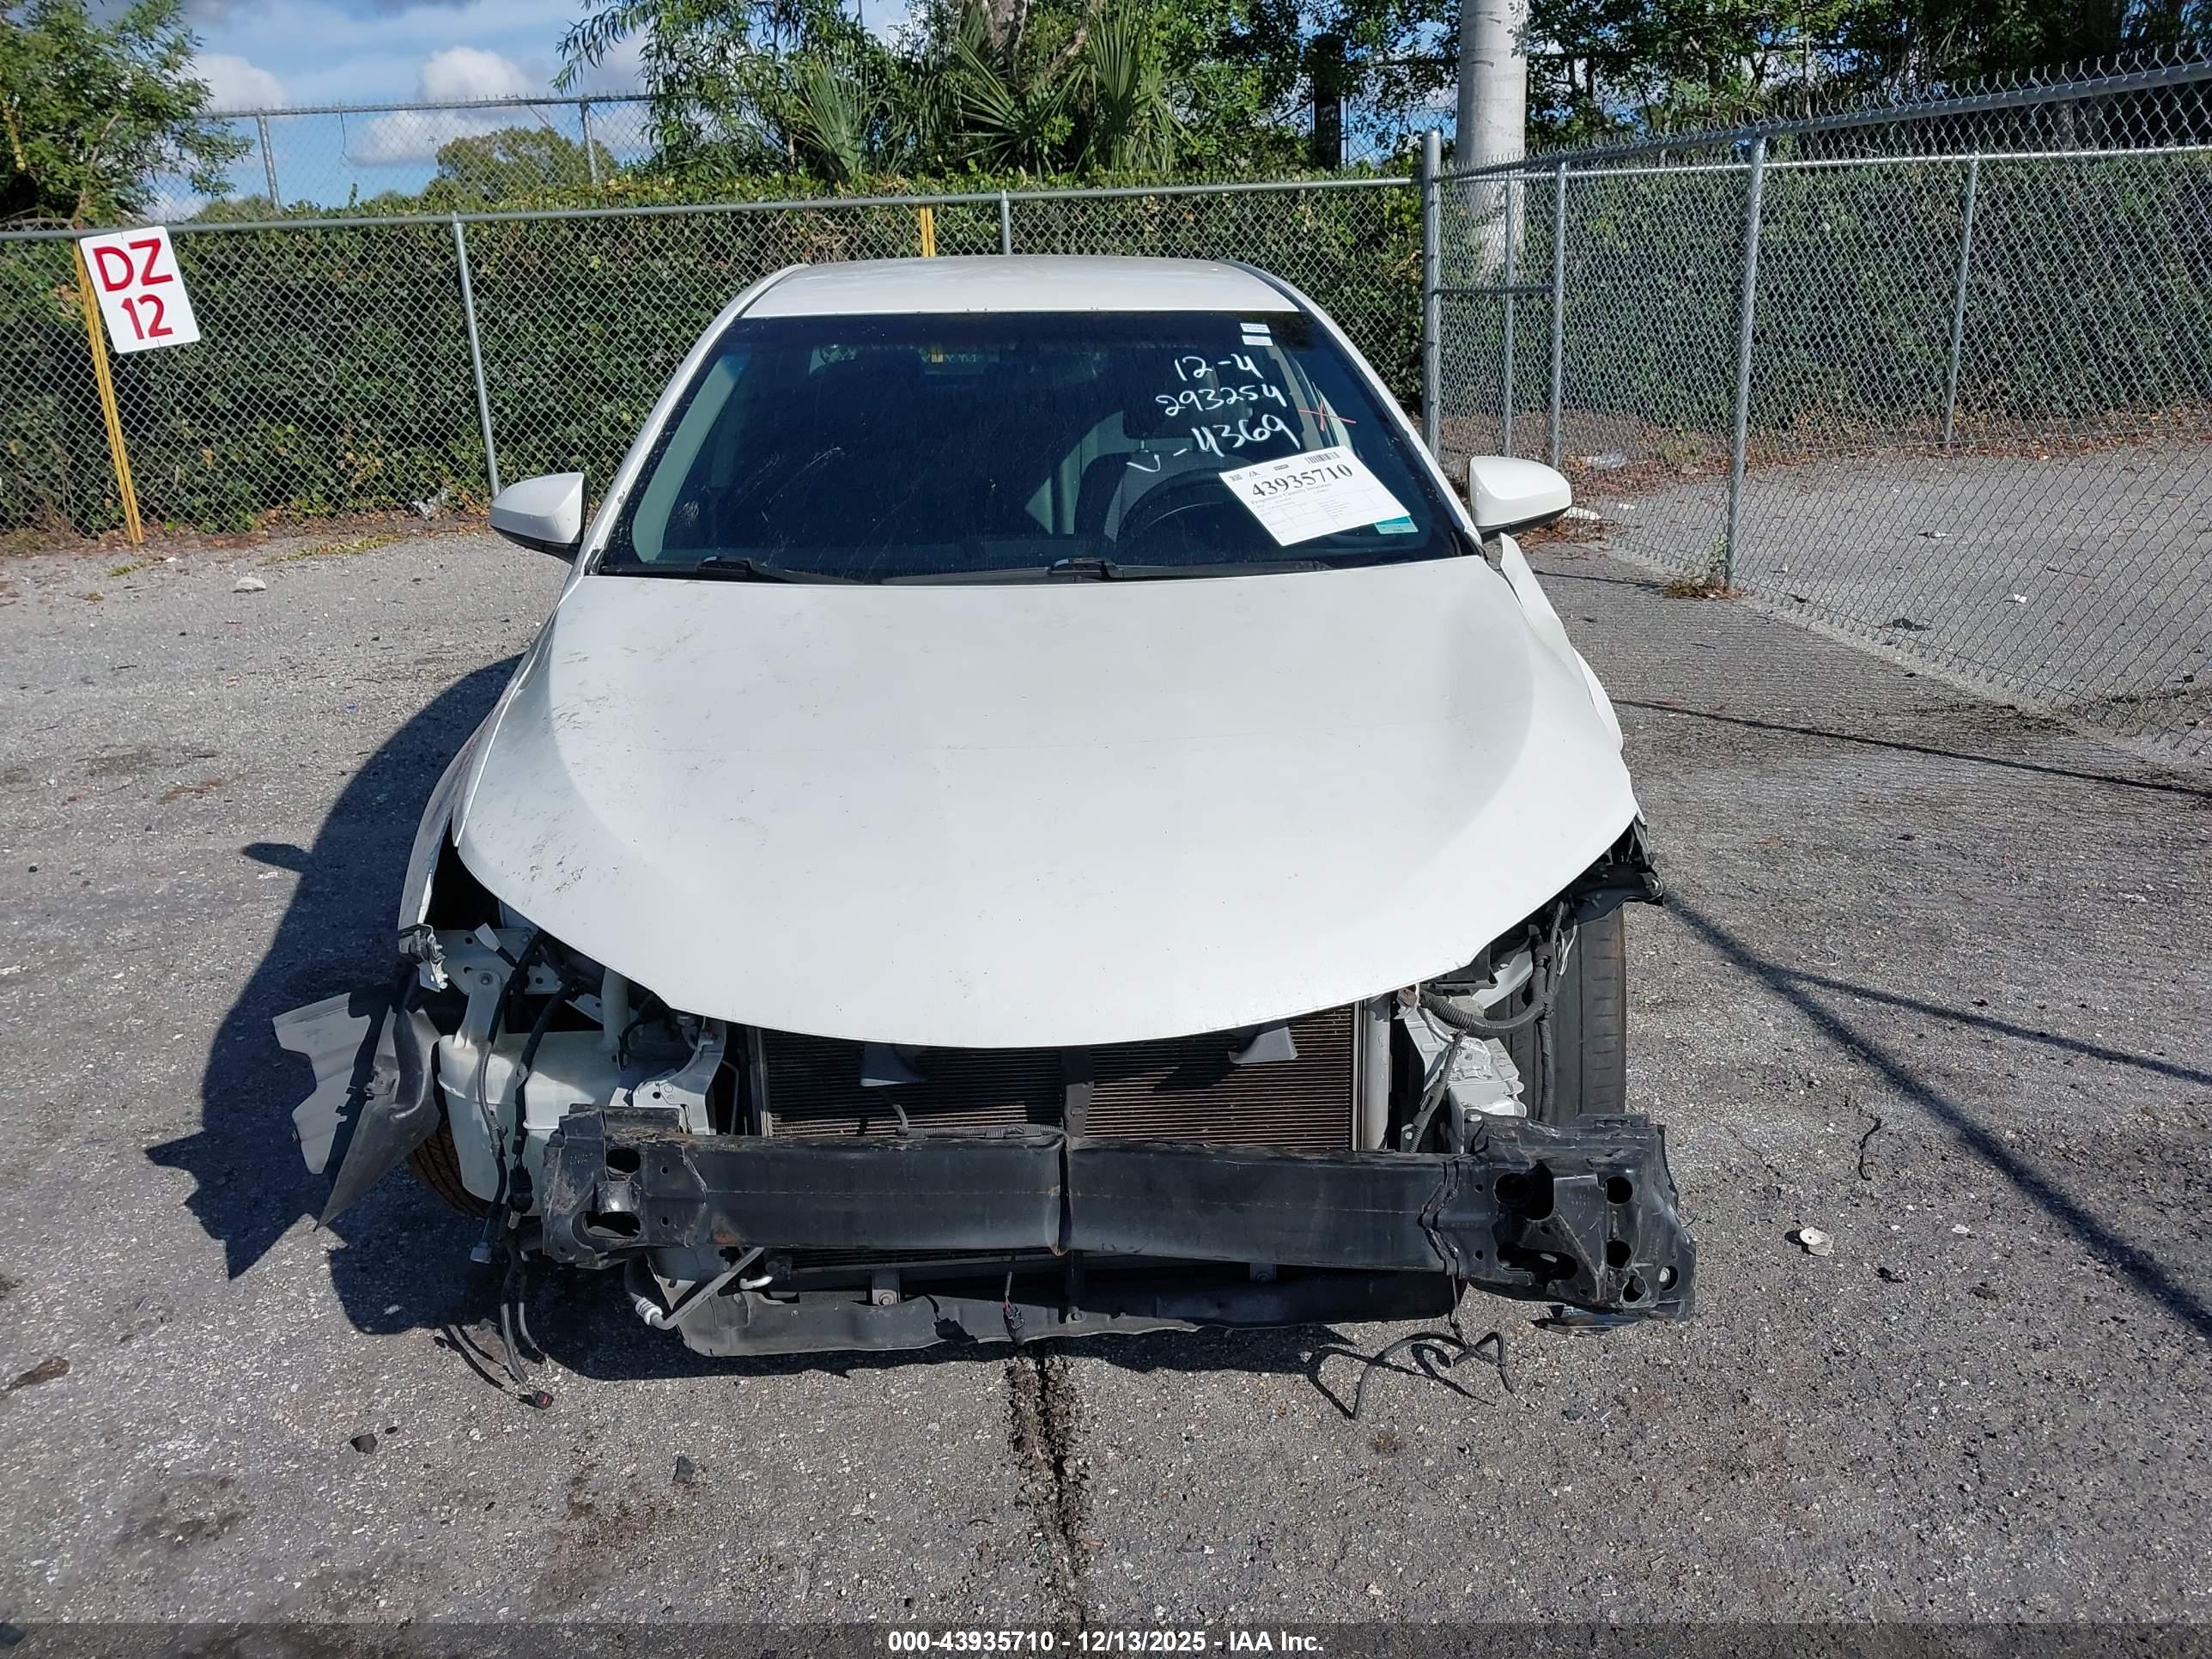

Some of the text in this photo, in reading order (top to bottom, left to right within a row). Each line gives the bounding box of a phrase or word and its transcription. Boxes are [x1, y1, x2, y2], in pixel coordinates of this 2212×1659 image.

[93, 238, 174, 292] DZ
[121, 294, 173, 340] 12
[1174, 354, 1263, 382] 12-4
[1155, 384, 1287, 416] 293254
[1252, 464, 1352, 496] 43935710
